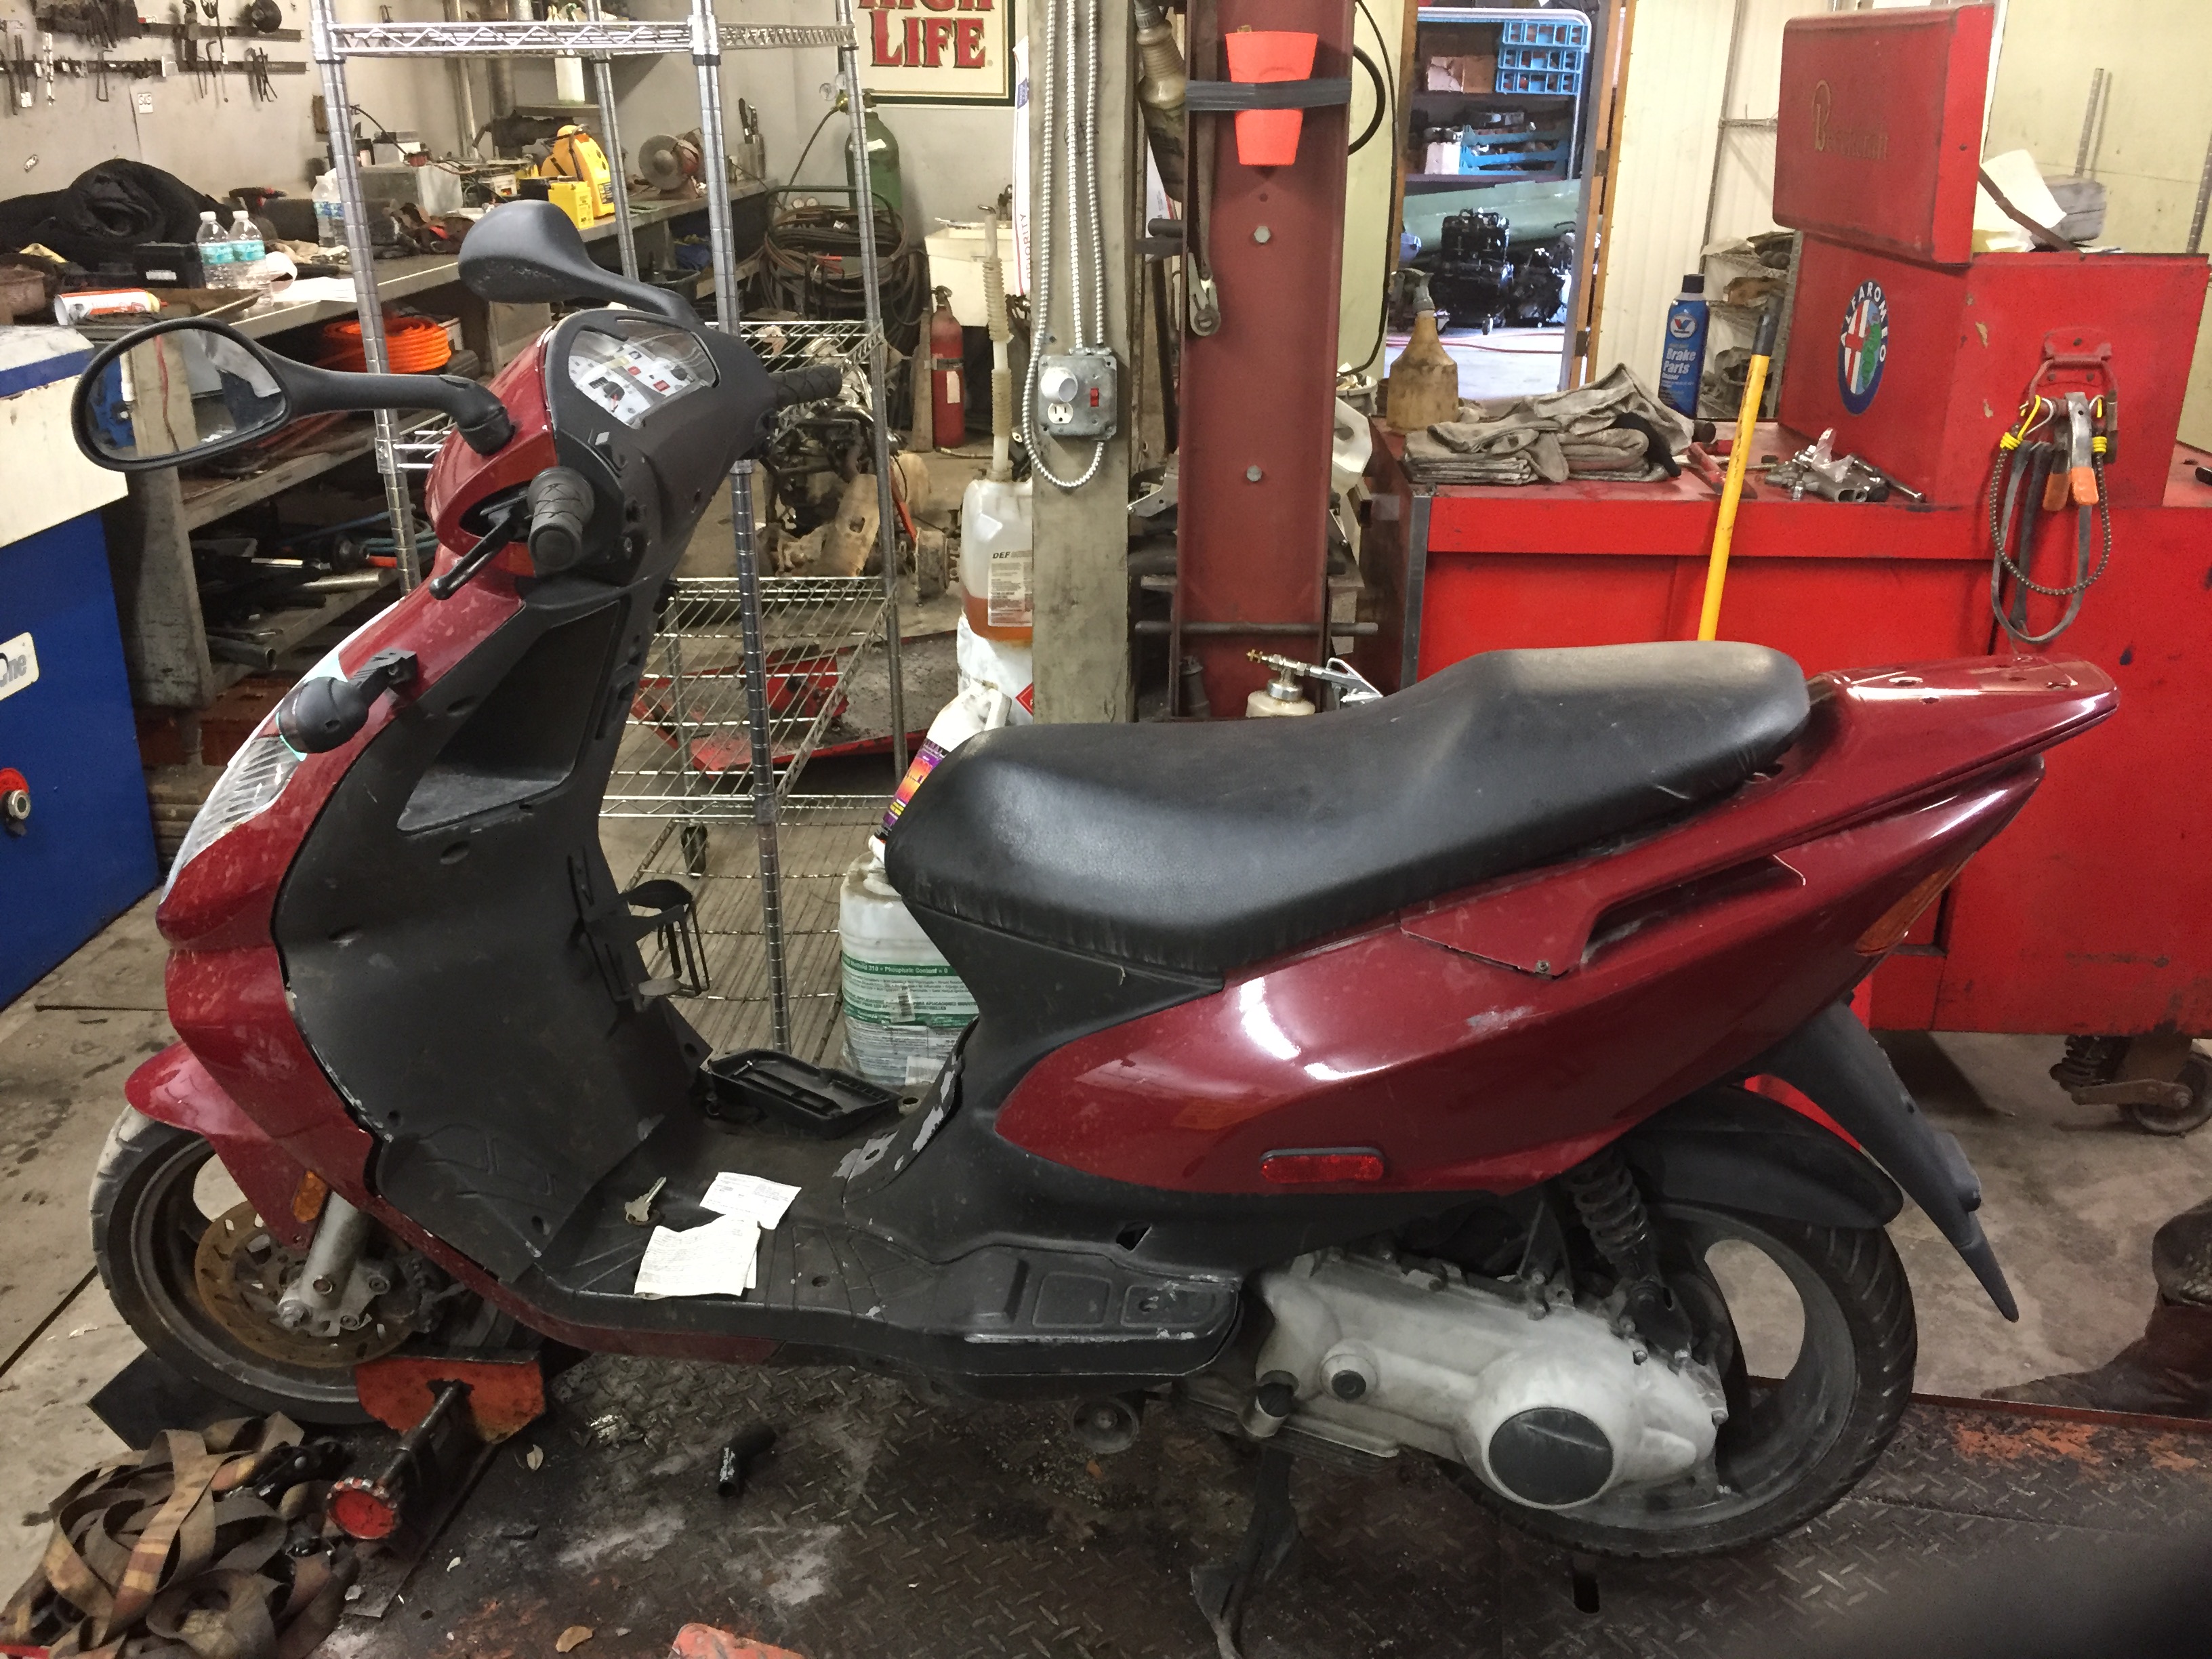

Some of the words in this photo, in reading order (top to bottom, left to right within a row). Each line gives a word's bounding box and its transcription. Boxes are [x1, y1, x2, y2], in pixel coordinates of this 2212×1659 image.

[869, 8, 986, 68] LIFE
[1666, 348, 1696, 361] Brake
[1663, 361, 1690, 374] Parts
[992, 551, 1010, 559] DEF
